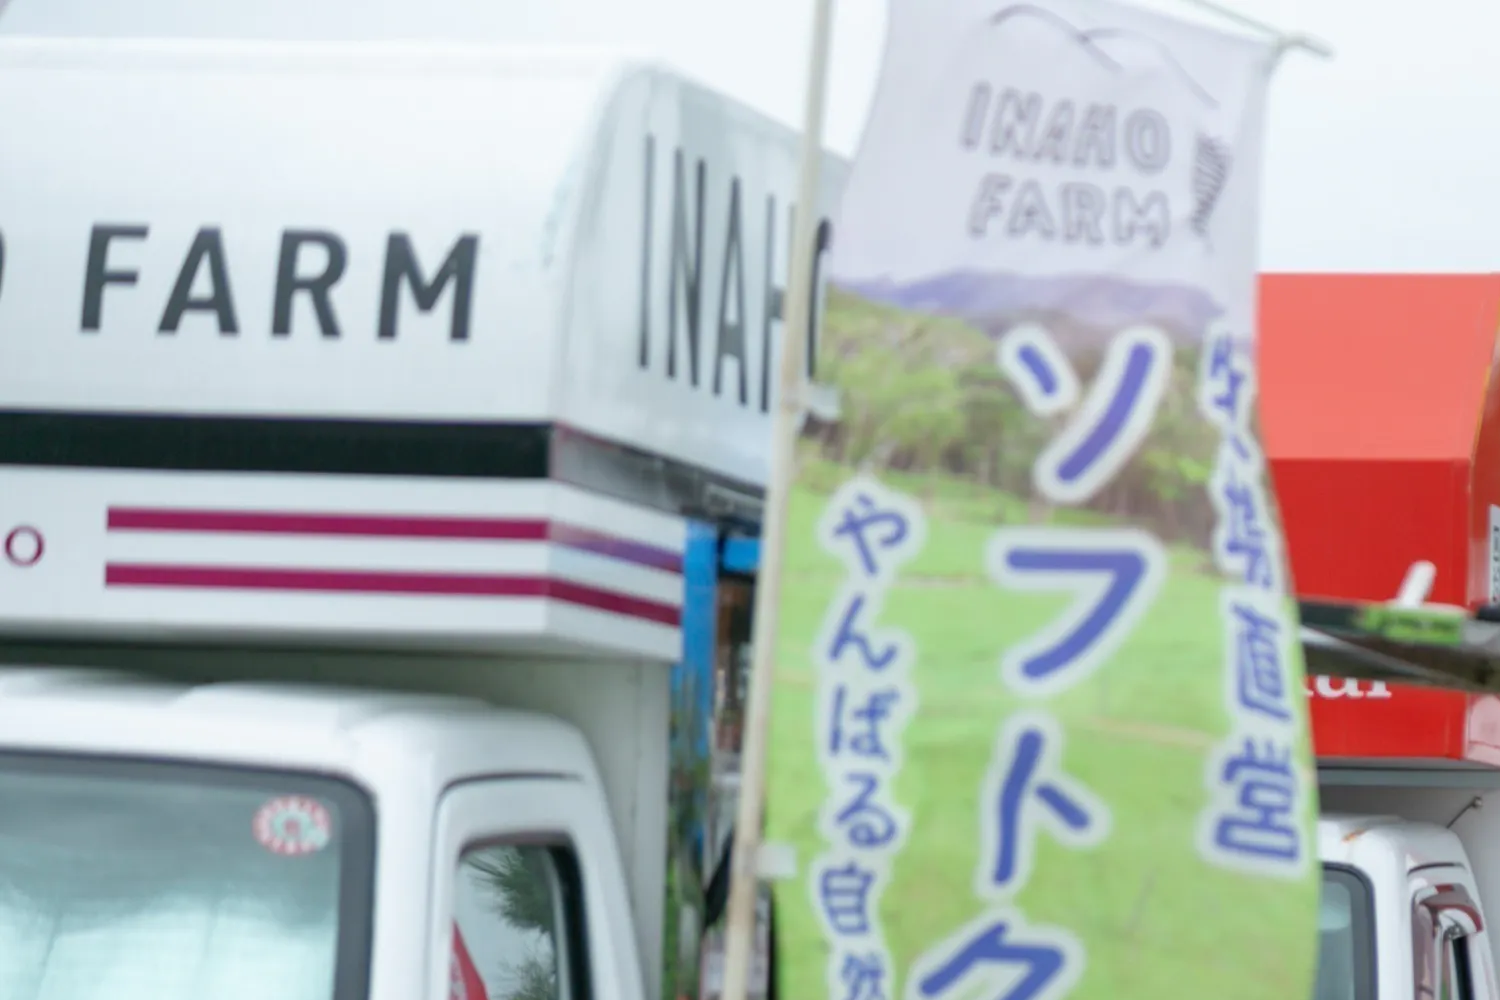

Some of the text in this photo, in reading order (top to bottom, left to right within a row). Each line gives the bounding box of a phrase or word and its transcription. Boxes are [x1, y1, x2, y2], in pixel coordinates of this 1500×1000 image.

[960, 82, 1172, 173] INAHO
[966, 173, 1172, 249] FARM
[80, 222, 481, 343] FARM
